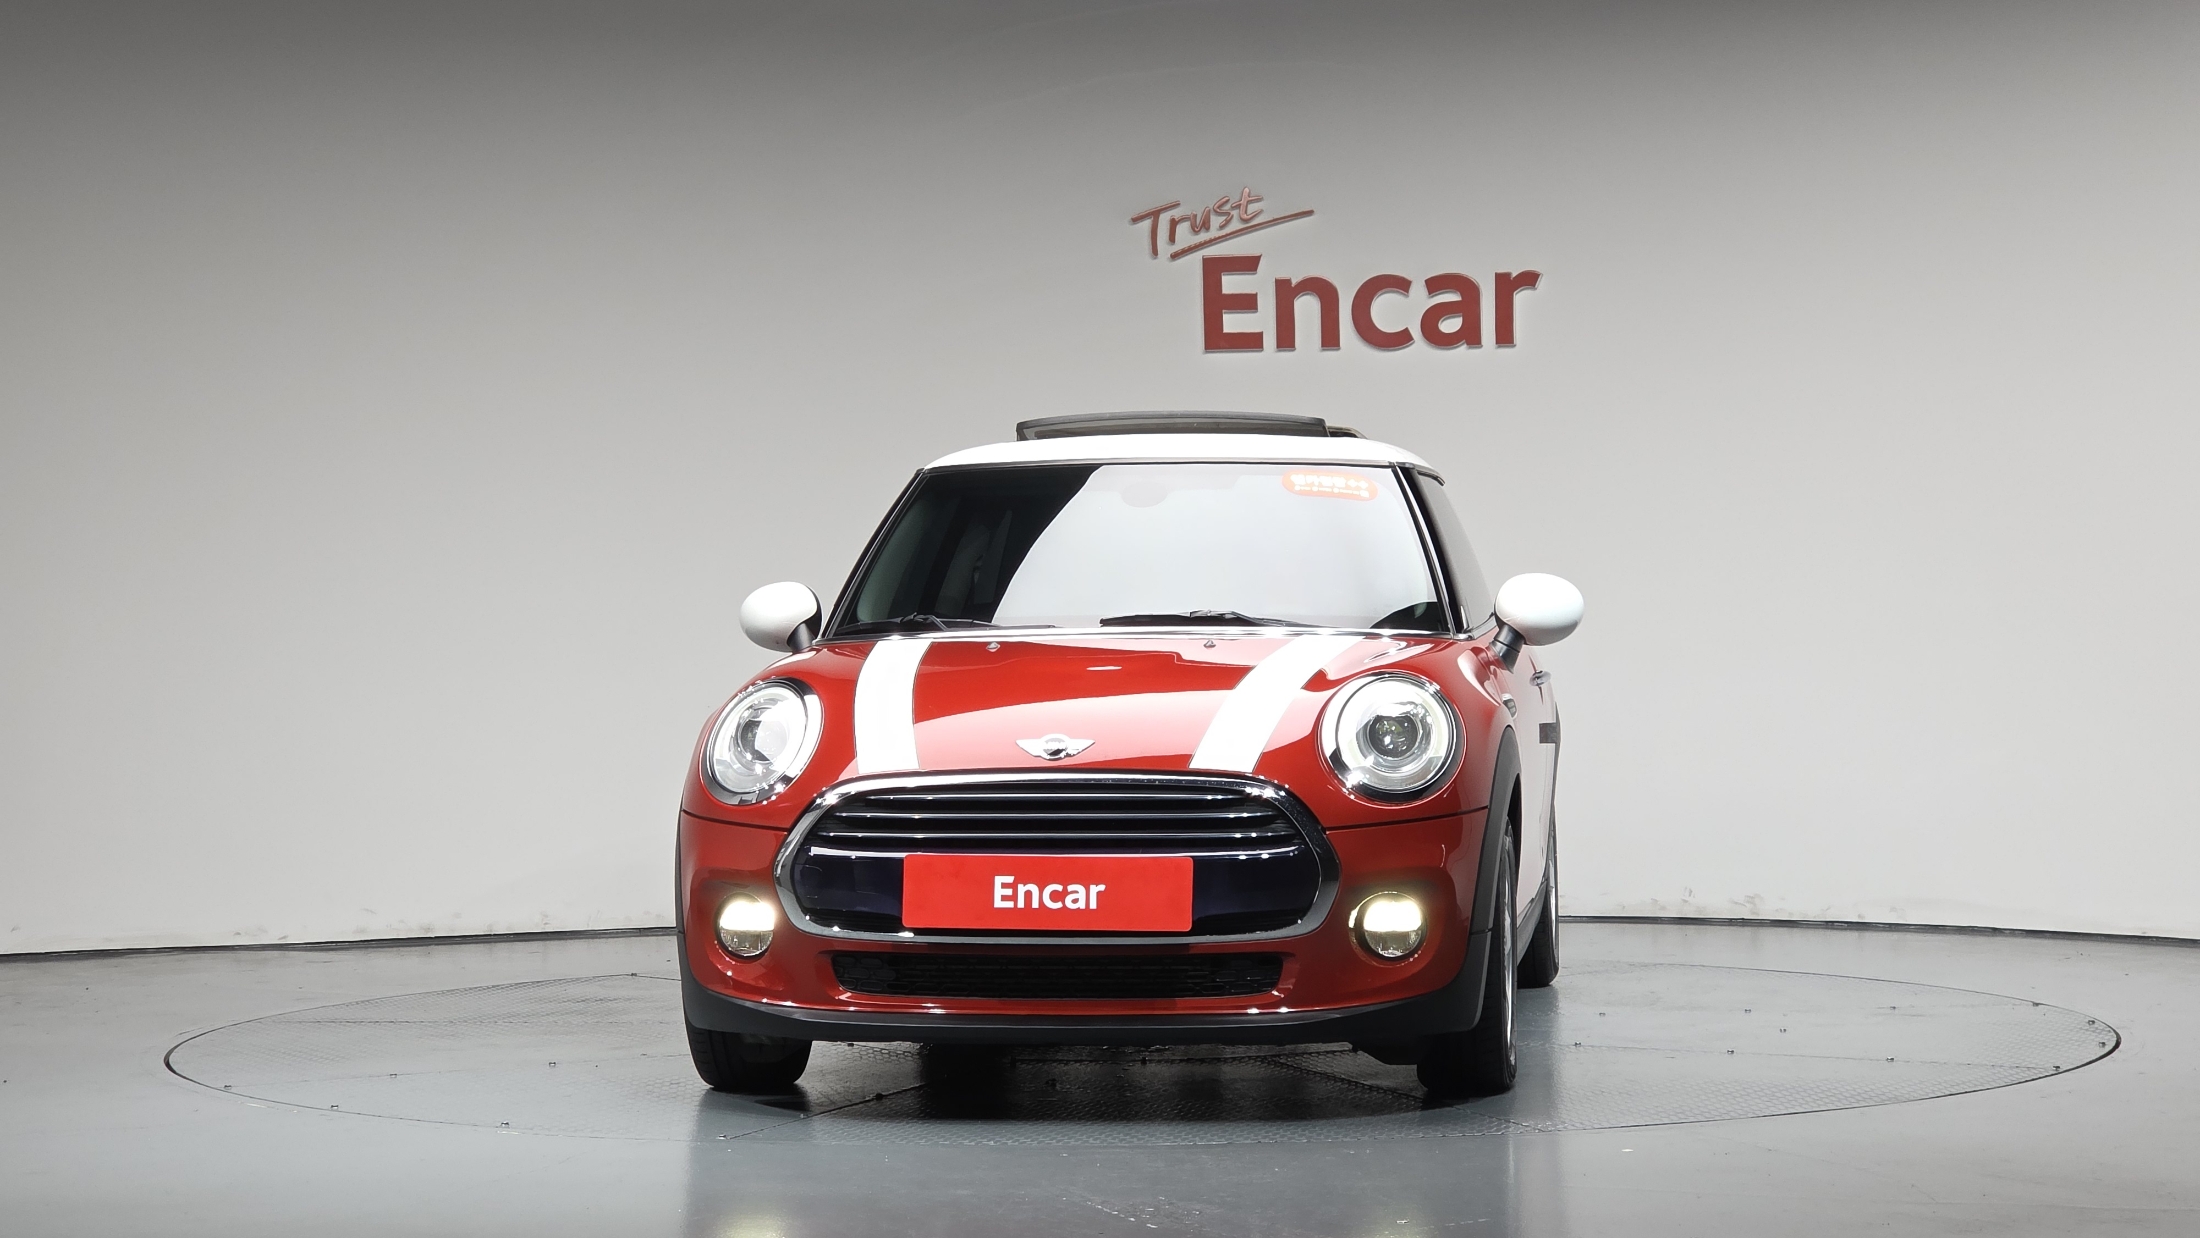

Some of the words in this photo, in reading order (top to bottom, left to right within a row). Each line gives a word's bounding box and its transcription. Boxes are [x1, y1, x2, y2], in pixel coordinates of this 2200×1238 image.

[1130, 186, 1264, 258] Trust
[1201, 253, 1543, 352] Encar
[993, 875, 1106, 910] Encar
